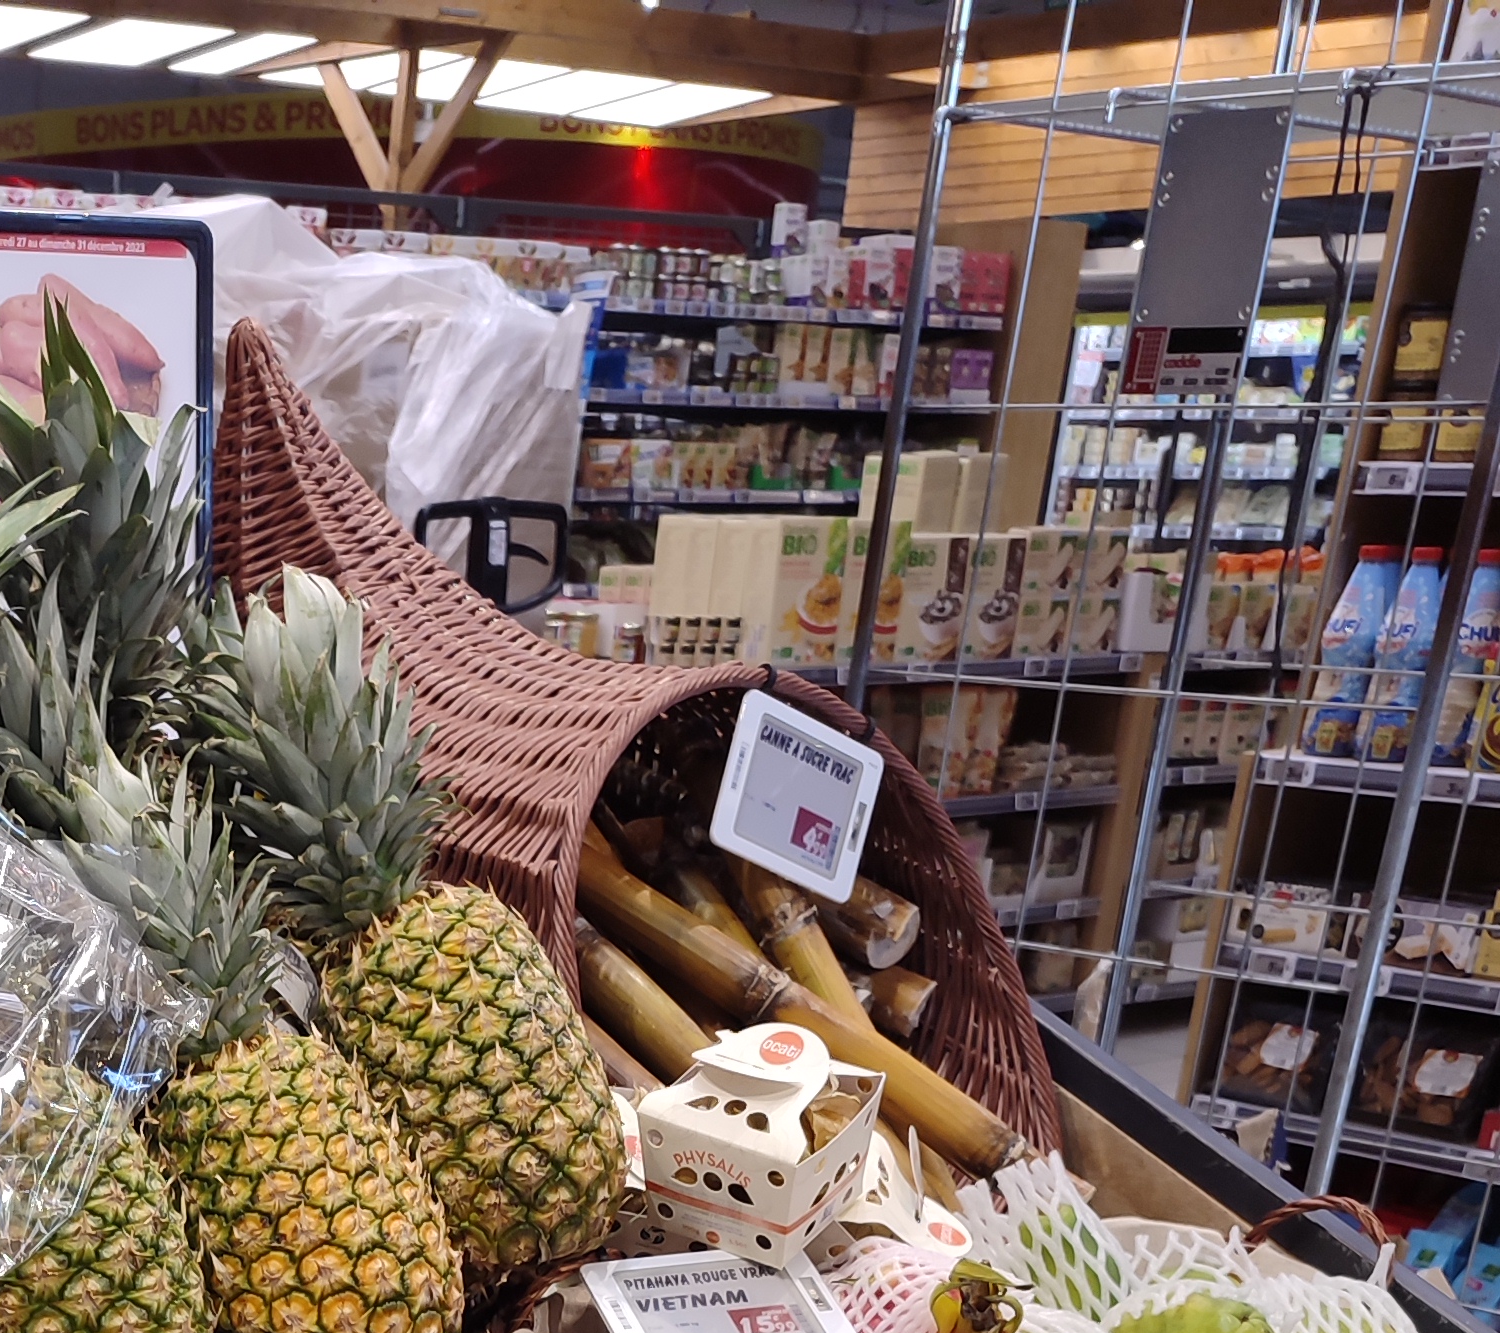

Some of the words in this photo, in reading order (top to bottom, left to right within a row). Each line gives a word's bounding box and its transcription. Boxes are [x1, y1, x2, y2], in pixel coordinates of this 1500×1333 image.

[75, 111, 145, 145] BONS
[149, 102, 245, 139] PLANS
[252, 101, 275, 133] &
[17, 236, 27, 247] 27
[28, 239, 38, 248] au
[39, 237, 76, 250] dimanche
[77, 239, 87, 250] 31
[87, 239, 124, 252] décembre
[125, 242, 145, 253] 2023
[792, 740, 802, 759] A
[800, 745, 831, 774] SUCRE
[829, 759, 855, 785] VRAC
[762, 1038, 802, 1060] ocati
[673, 1149, 751, 1189] PHYSALIS
[624, 1272, 689, 1291] PITAHAYA
[693, 1268, 738, 1285] ROUGE
[635, 1289, 749, 1313] VIETNAM
